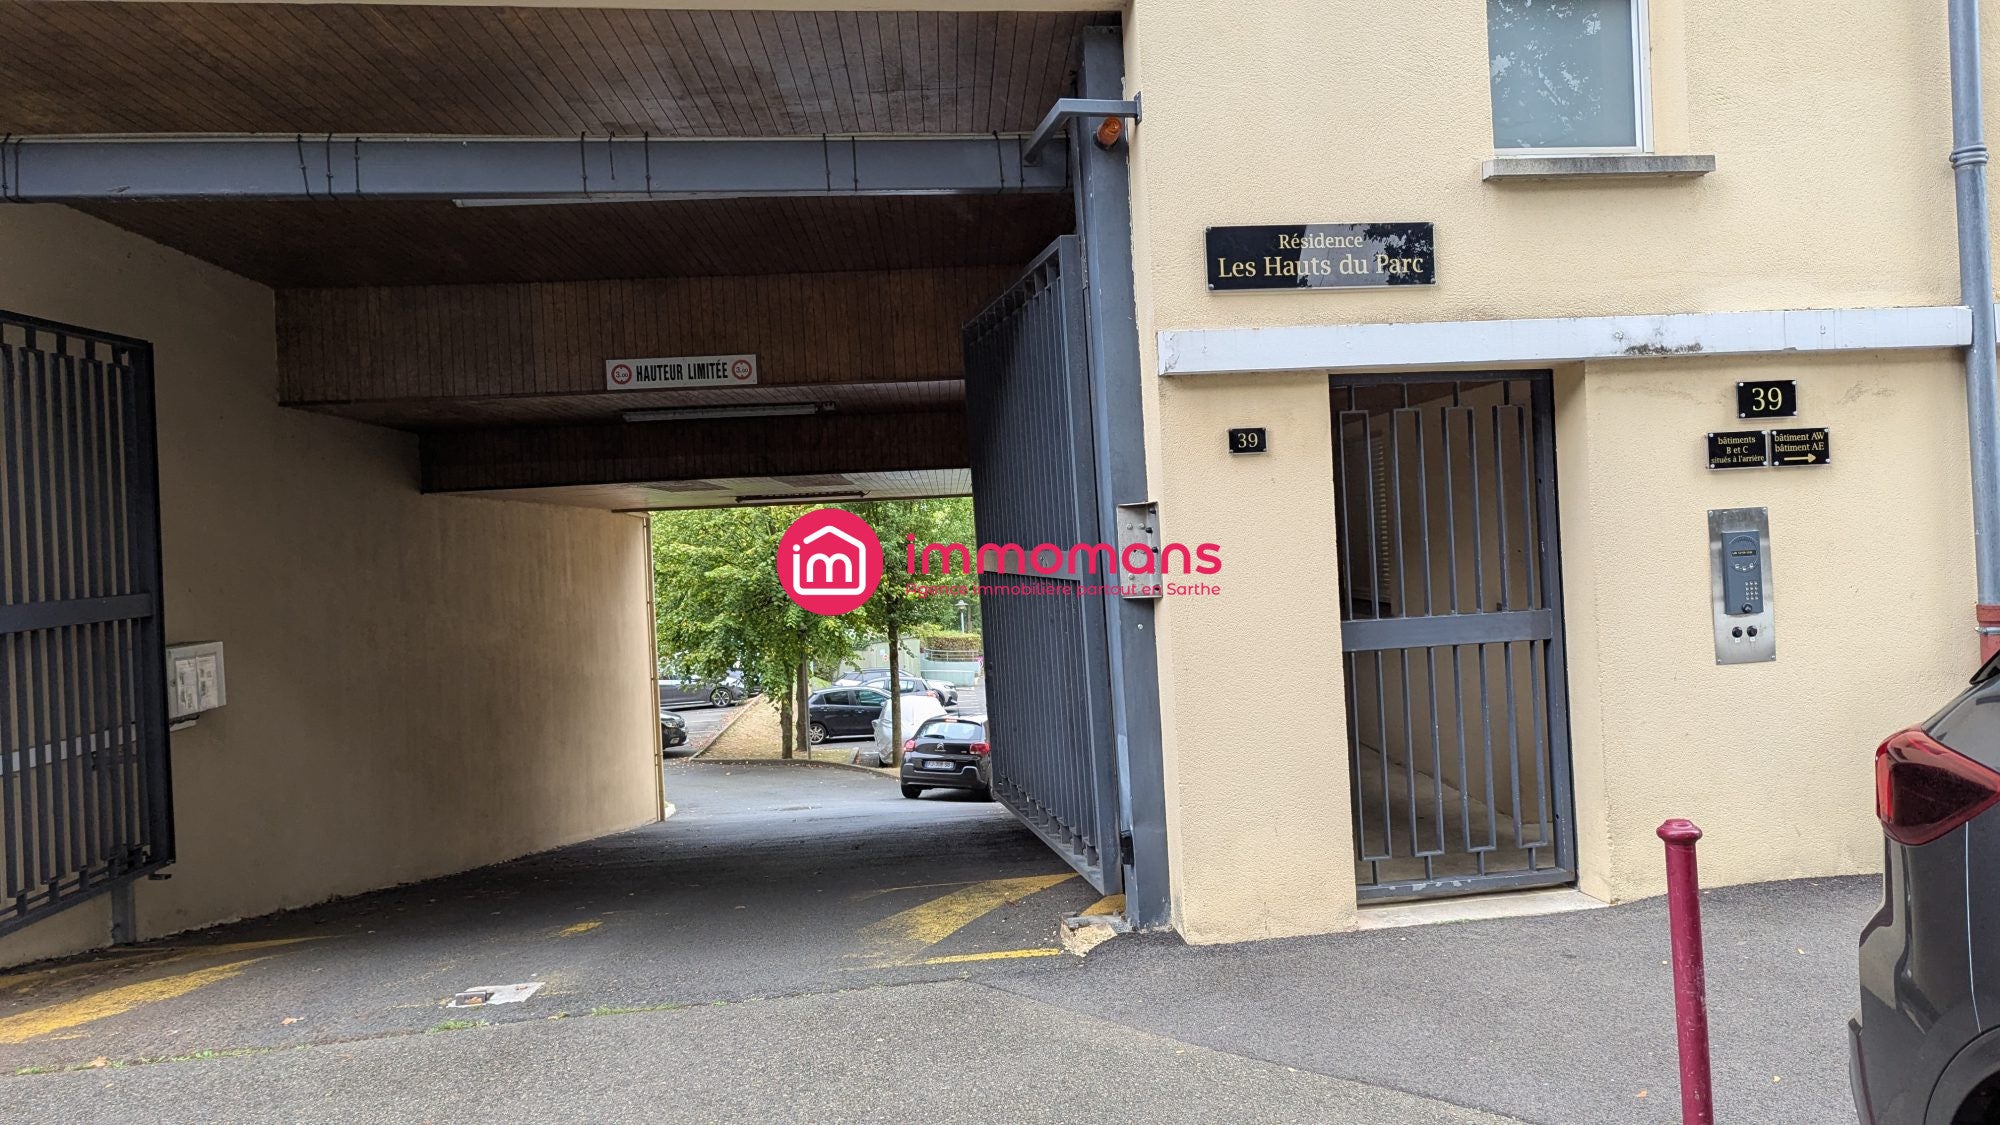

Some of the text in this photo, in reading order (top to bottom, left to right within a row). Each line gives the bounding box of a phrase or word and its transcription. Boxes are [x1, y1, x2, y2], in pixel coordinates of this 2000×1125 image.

[1278, 232, 1364, 249] Résidence
[1217, 253, 1424, 278] Les Hauts du Parc
[636, 363, 683, 382] HAUTEUR
[687, 359, 729, 380] LIMITÉE
[1752, 387, 1783, 411] 39
[1237, 432, 1258, 448] 39
[1717, 436, 1756, 445] bâtiments
[1774, 431, 1825, 442] bâtiment AW
[1726, 445, 1749, 454] B et C
[1774, 441, 1825, 453] bâtiment AE
[1711, 454, 1765, 464] situés à l'arrière
